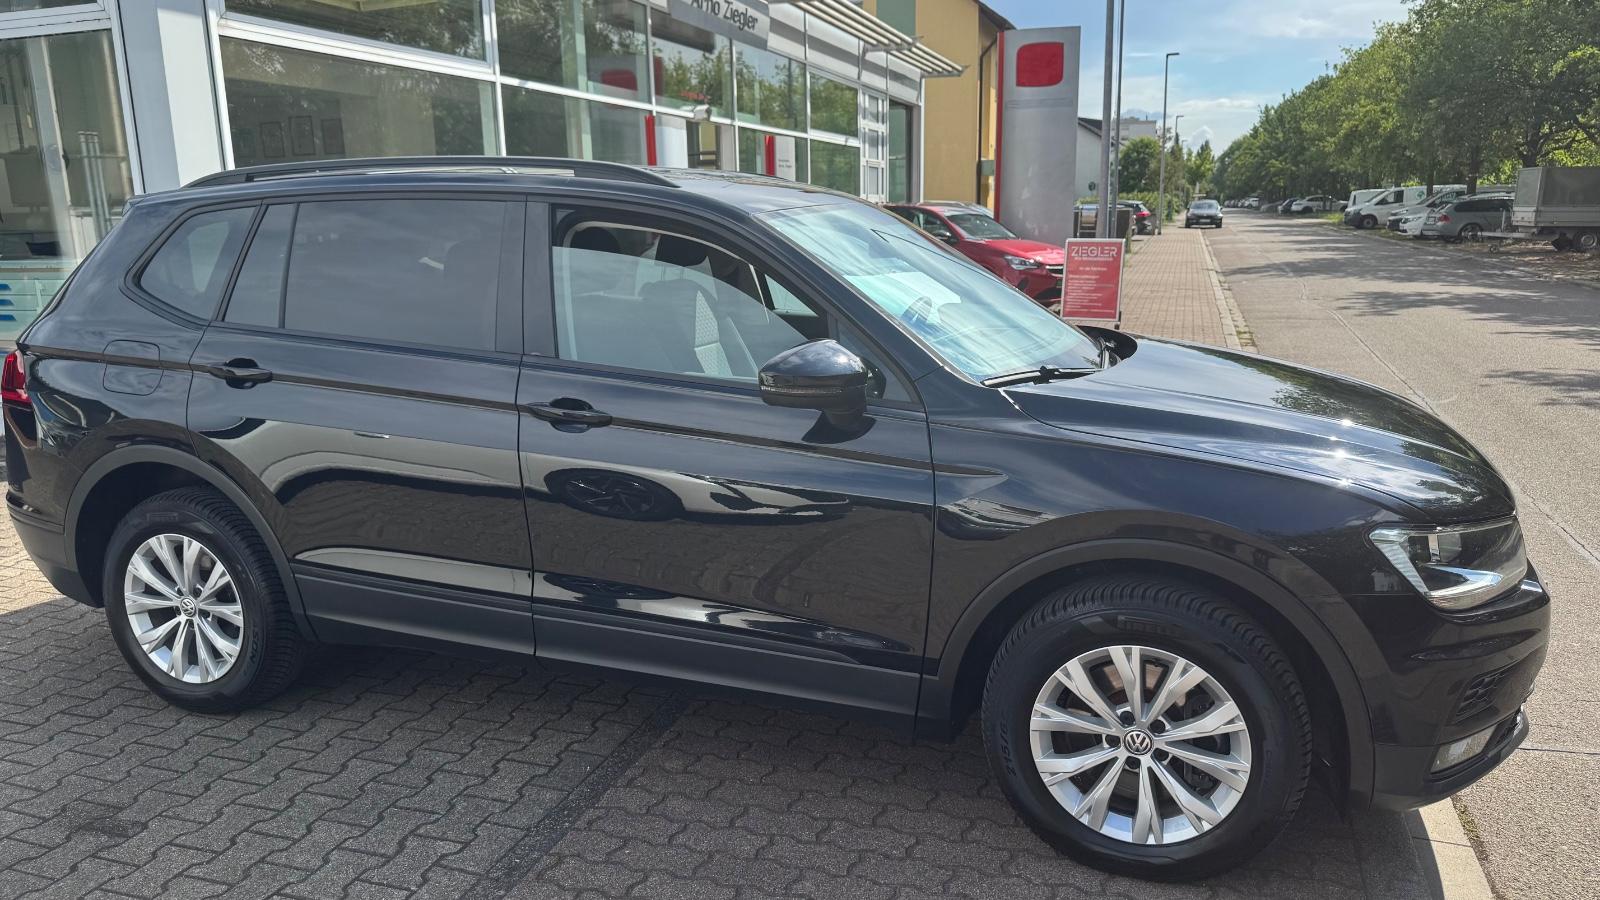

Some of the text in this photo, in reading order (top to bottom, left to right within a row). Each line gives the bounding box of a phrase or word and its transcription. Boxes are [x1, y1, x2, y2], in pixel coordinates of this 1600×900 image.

[723, 0, 758, 31] Ziegler
[1071, 246, 1117, 257] ZIEGLER
[1125, 731, 1151, 753] VW
